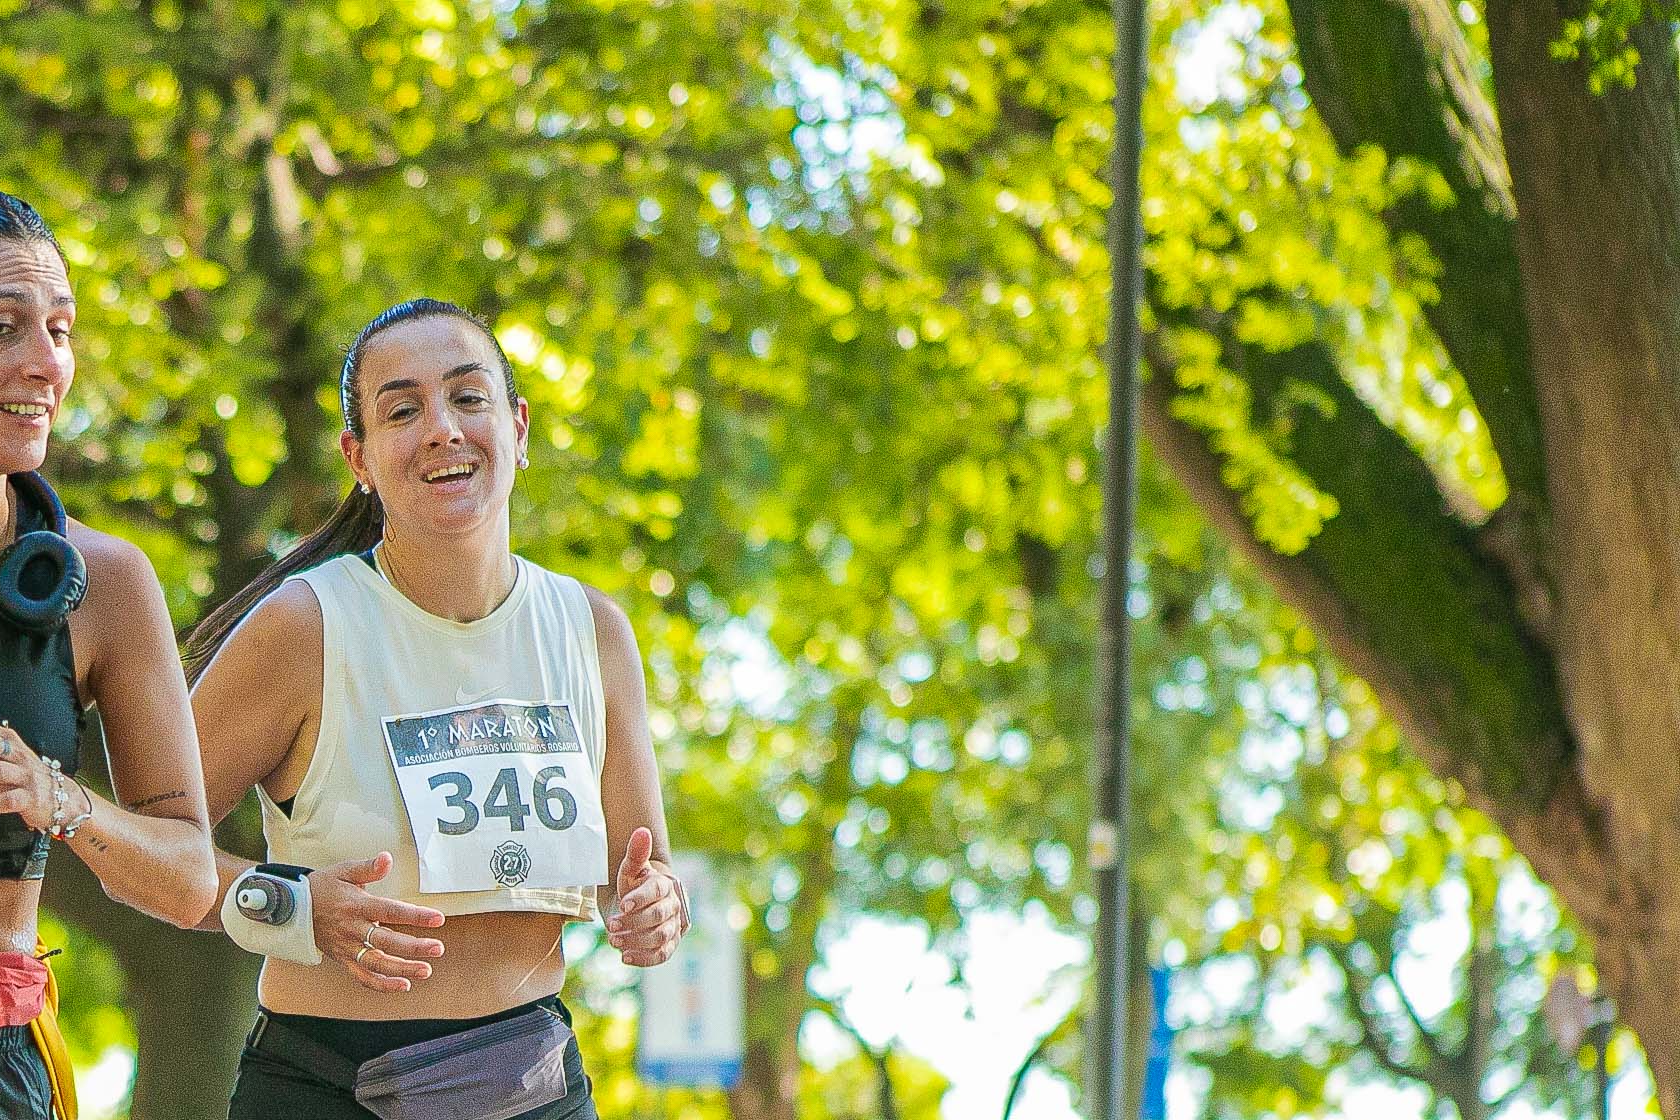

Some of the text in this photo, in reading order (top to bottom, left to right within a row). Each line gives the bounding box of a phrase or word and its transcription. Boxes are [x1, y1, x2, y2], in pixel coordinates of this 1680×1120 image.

[448, 710, 557, 744] MARATÓN
[455, 743, 500, 757] BOMBEROS
[500, 741, 547, 753] VOLUNTARIOS
[547, 742, 579, 752] ROSARIO
[428, 766, 578, 835] 346
[503, 854, 519, 870] 27
